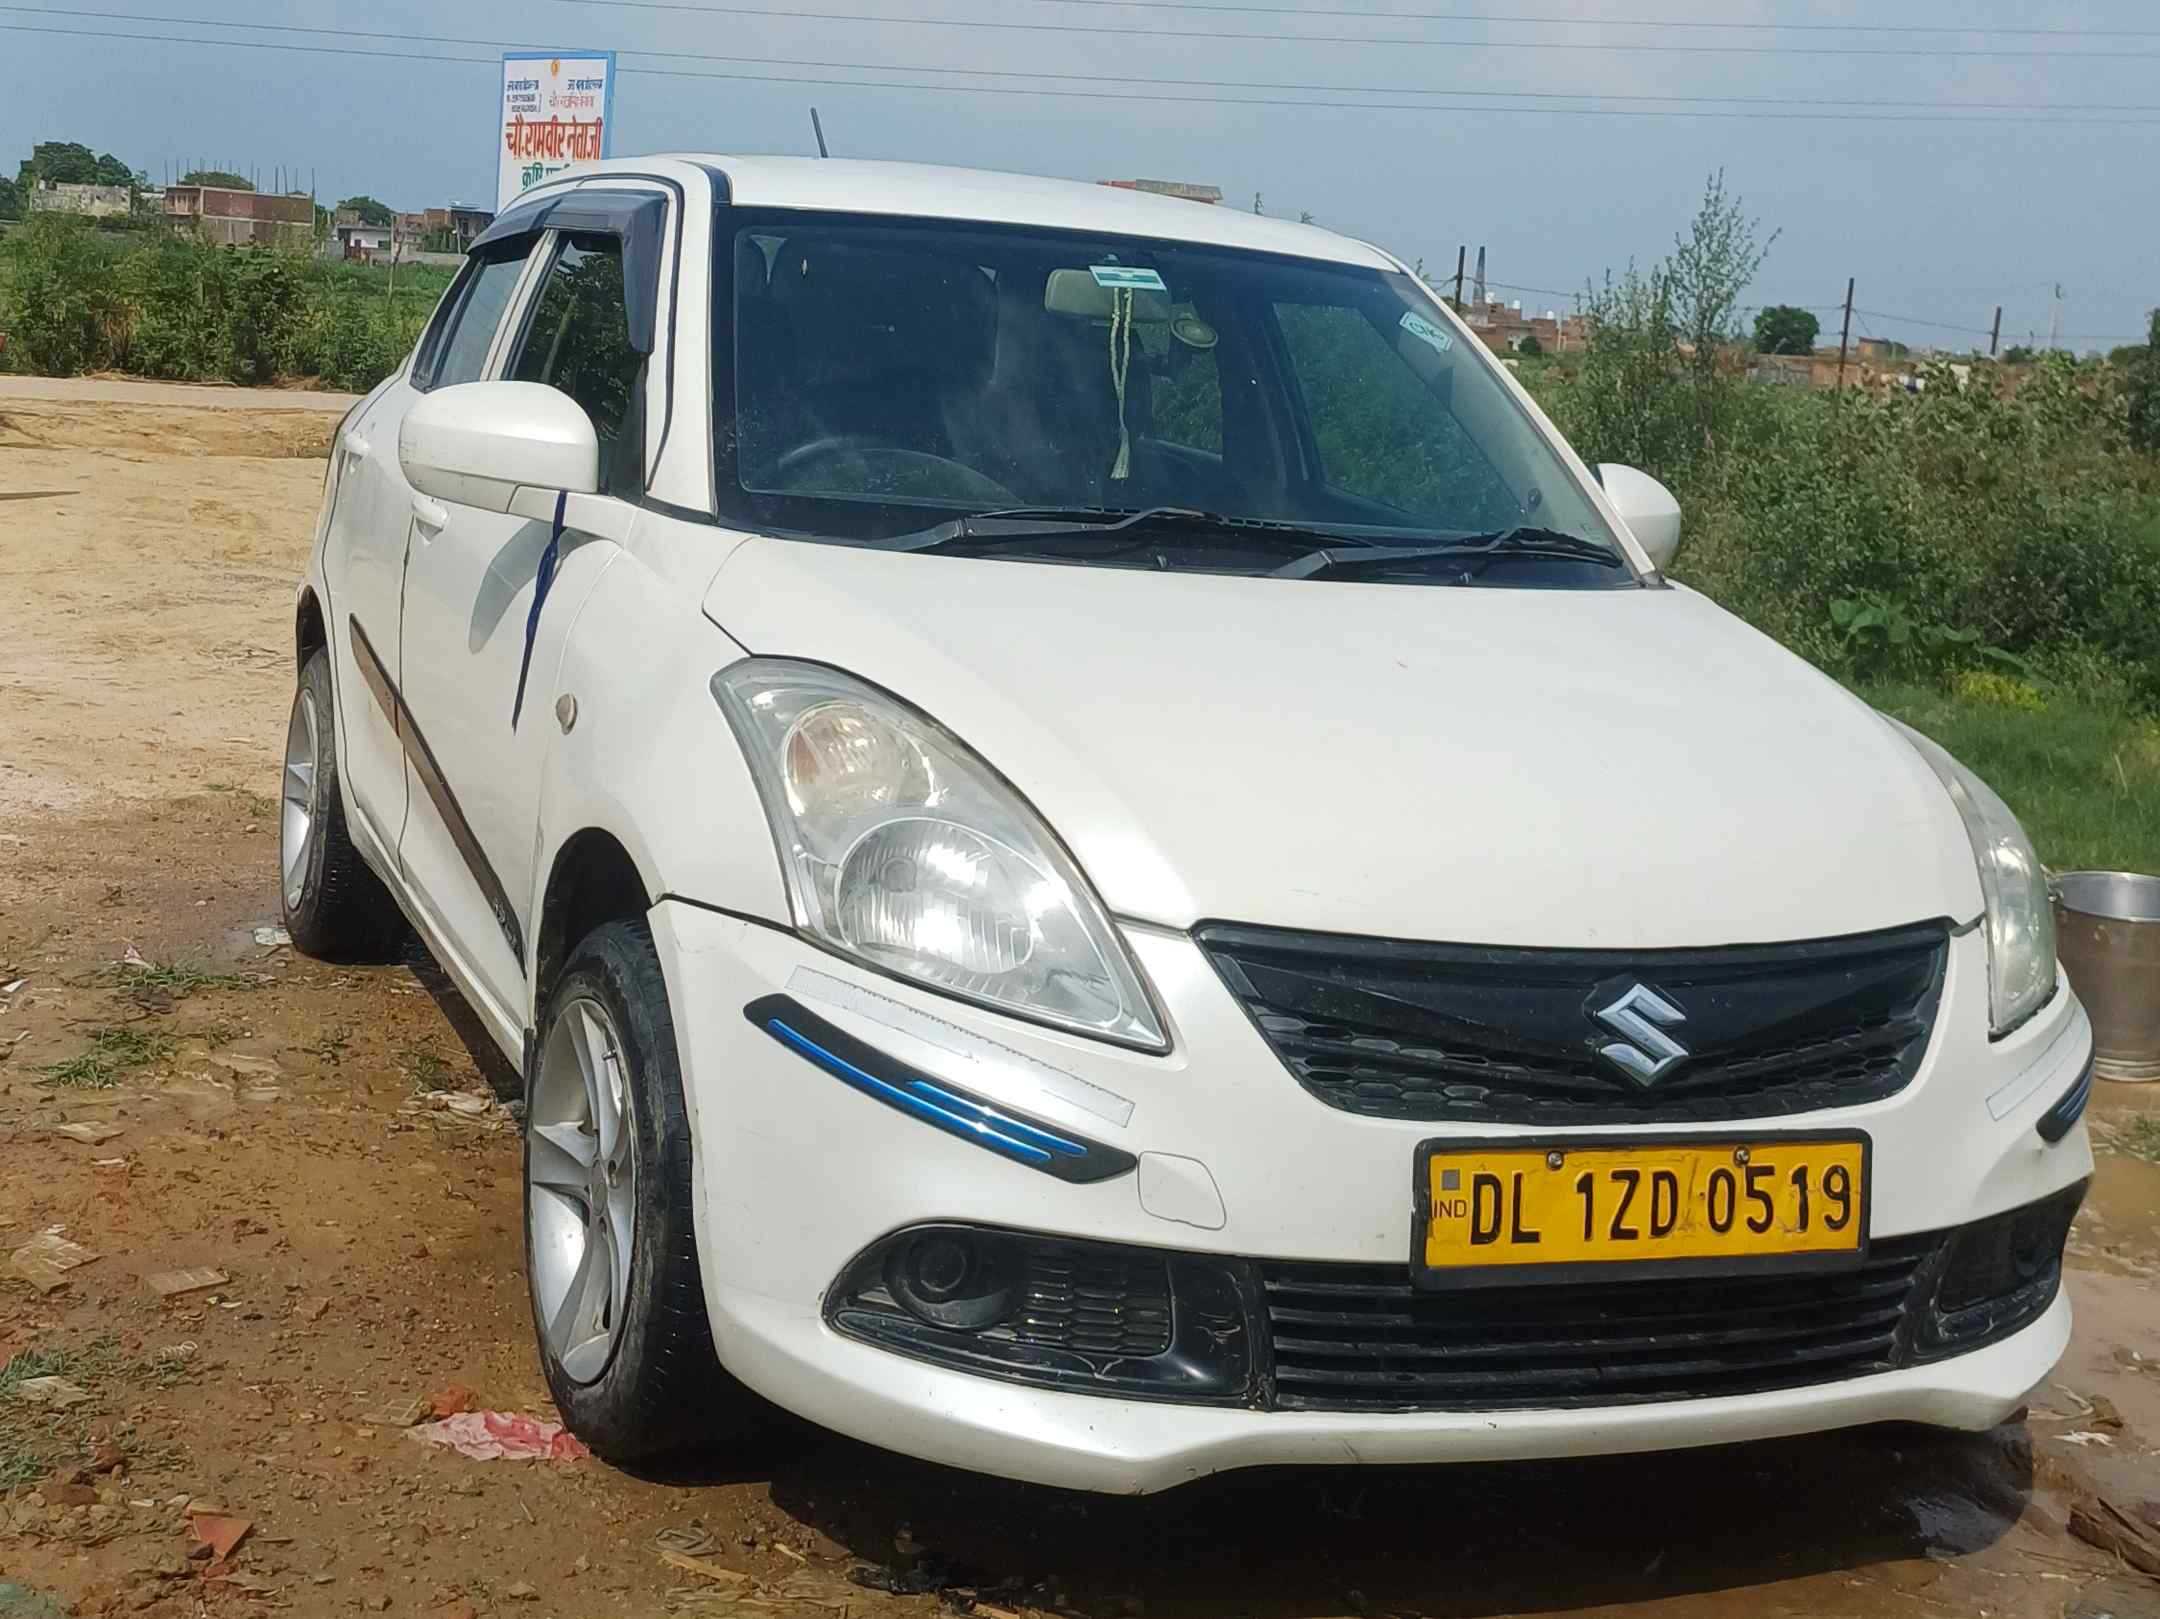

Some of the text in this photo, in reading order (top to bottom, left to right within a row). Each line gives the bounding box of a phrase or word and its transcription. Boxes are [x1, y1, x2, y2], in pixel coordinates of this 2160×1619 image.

[1433, 1199, 1467, 1220] IND
[1470, 1164, 1851, 1245] DL 1ZD 0519
